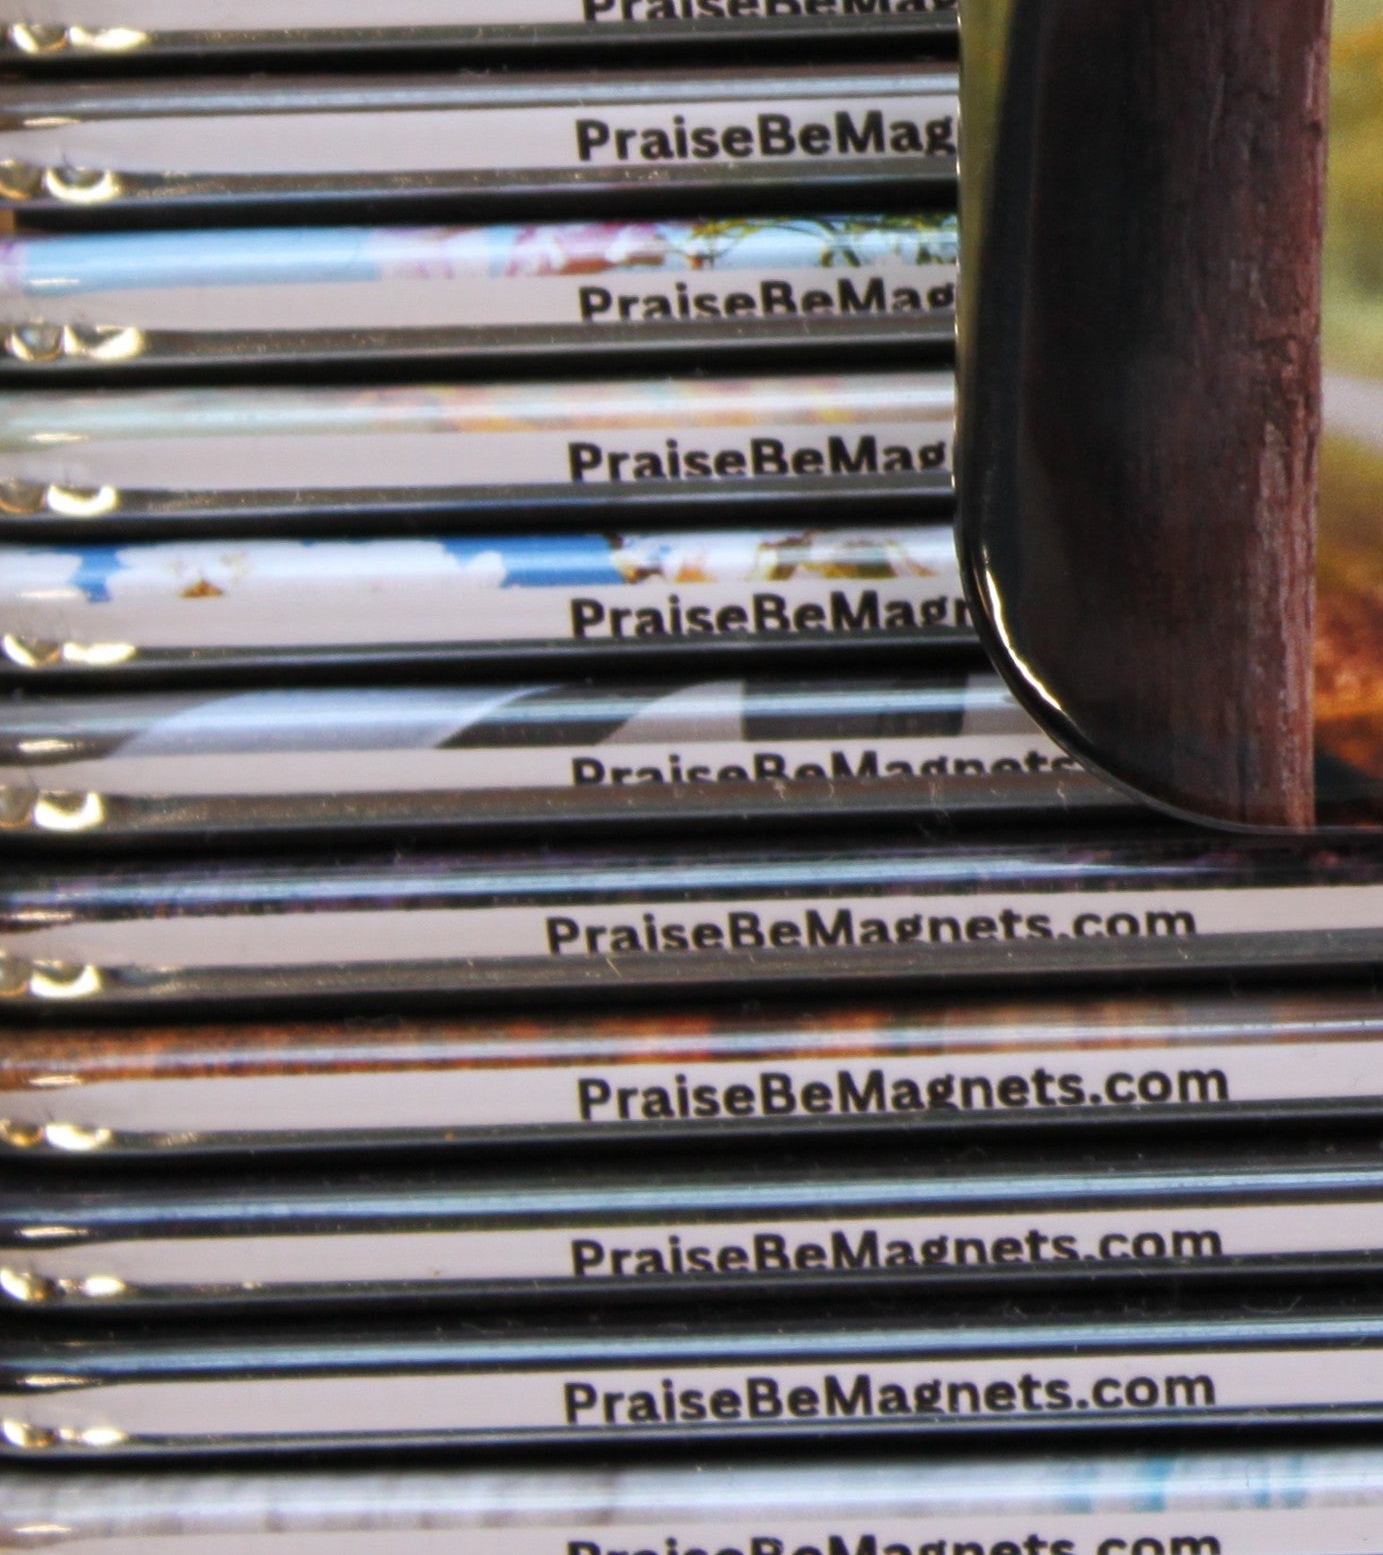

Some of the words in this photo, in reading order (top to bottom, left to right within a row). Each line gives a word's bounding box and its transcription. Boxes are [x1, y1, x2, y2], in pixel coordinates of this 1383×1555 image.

[574, 110, 956, 161] PraiseBeMag
[578, 276, 954, 322] PraiseBeMag
[567, 434, 948, 483] PraiseBeMag
[577, 1065, 1230, 1121] PraiseBeMagnets.com
[570, 1227, 1223, 1277] PraiseBeMagnets.com
[563, 1372, 1216, 1425] PraiseBeMagnets.com
